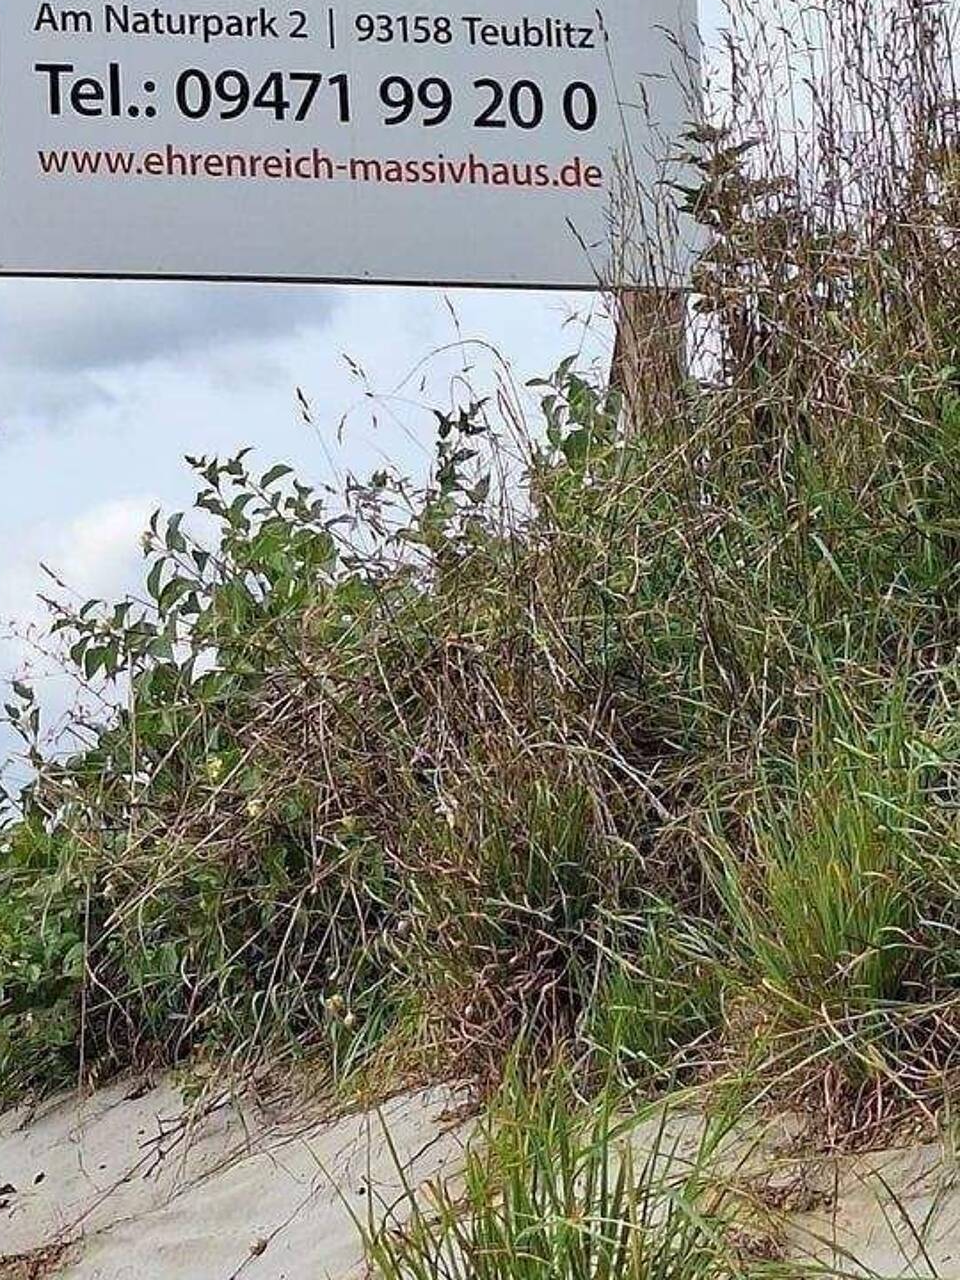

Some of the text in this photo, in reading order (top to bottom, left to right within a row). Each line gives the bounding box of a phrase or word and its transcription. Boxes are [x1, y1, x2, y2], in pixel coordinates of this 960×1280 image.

[34, 3, 595, 49] Am Naturpark 2 93158 Teublitz
[35, 64, 597, 130] Tel.: 09471 99 20 0
[38, 146, 603, 188] www.ehrenreich-massivhaus.de
